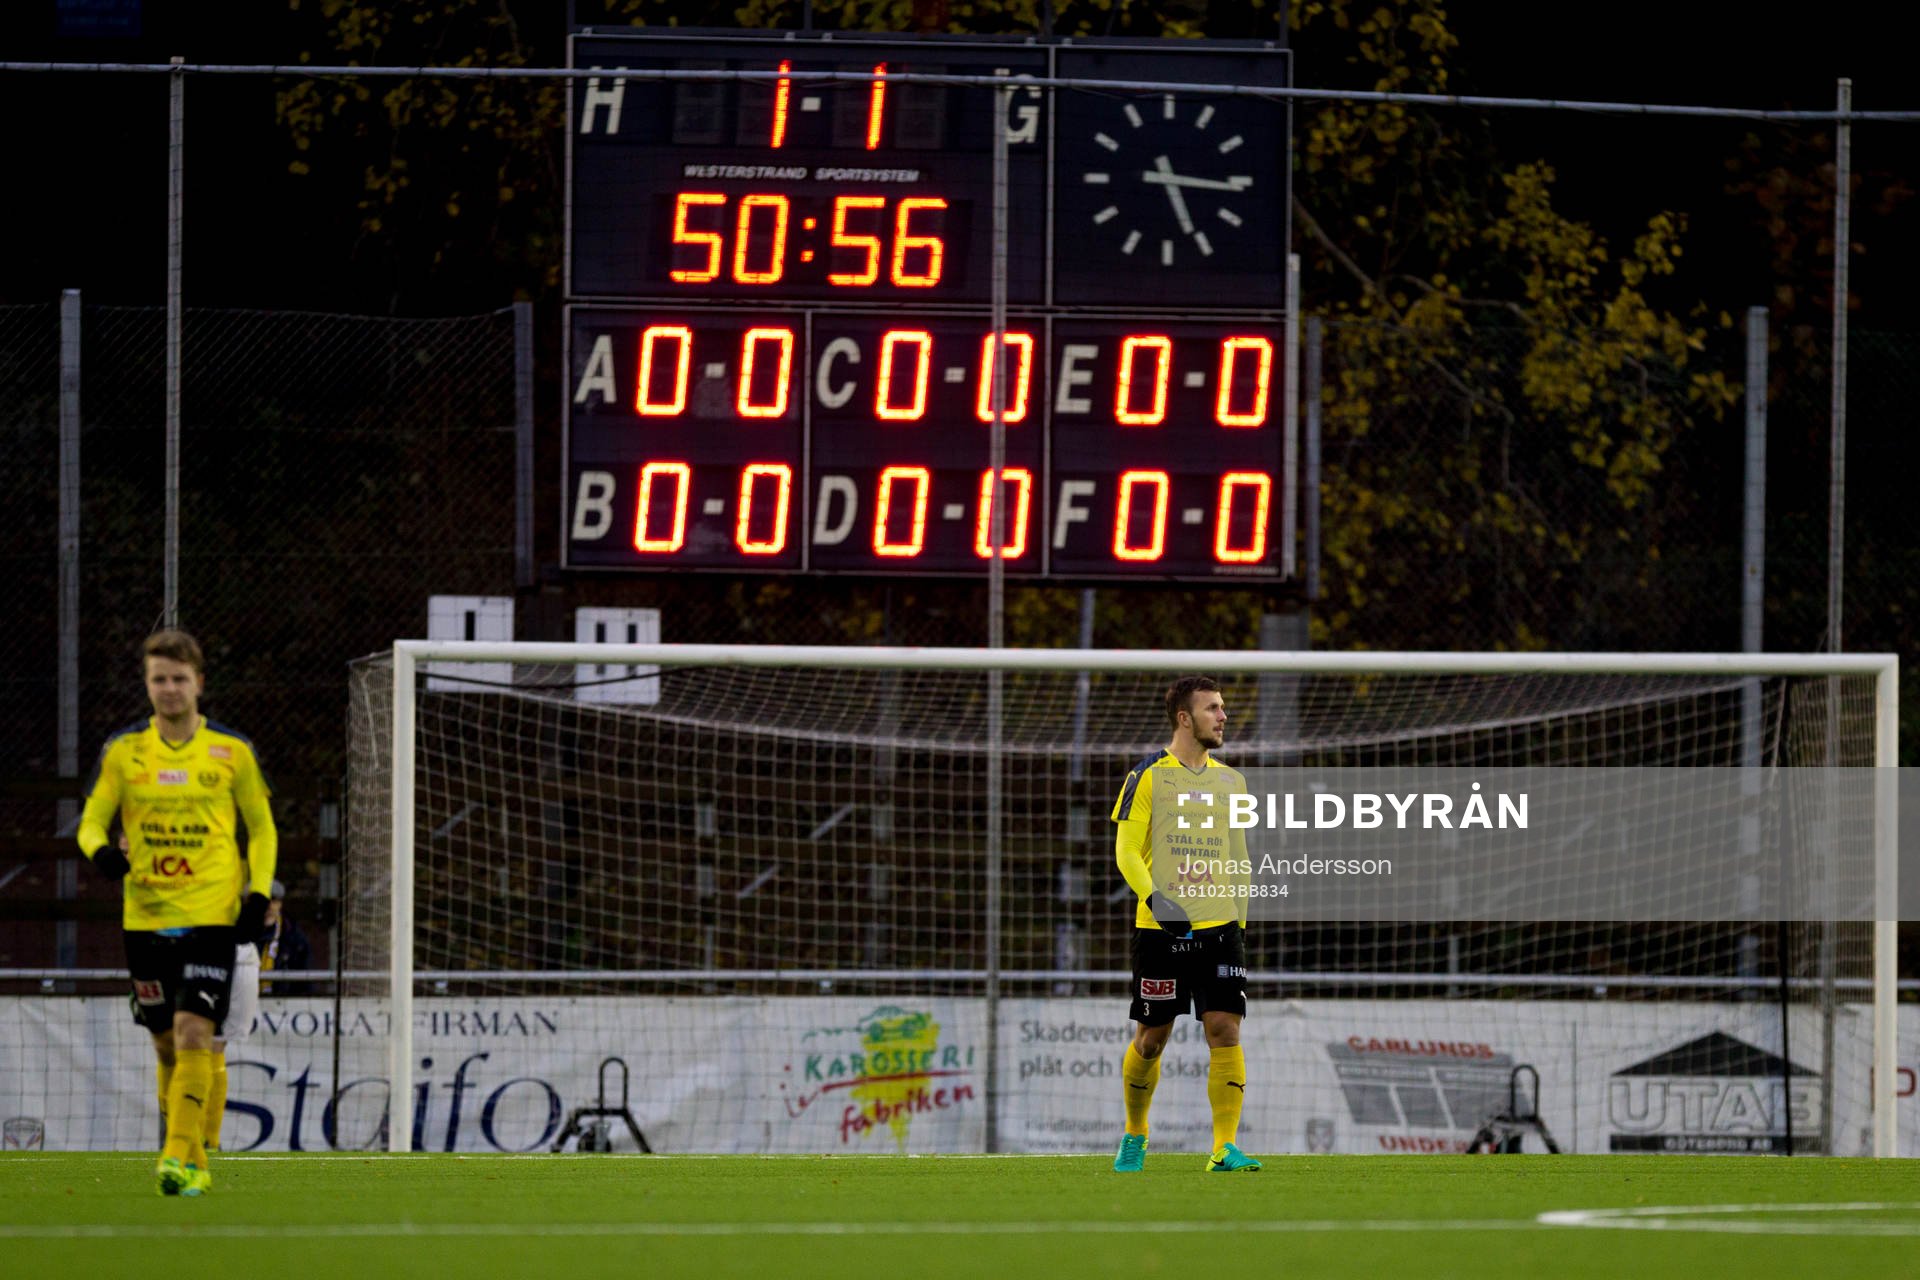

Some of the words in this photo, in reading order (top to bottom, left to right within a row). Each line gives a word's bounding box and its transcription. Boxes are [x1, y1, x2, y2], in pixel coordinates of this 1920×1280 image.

[581, 67, 628, 134] H
[685, 165, 807, 179] WESTERSTRAND
[816, 168, 920, 181] SPORTSYSTEM
[669, 192, 948, 287] 50:56
[575, 335, 617, 403] A
[816, 338, 861, 408] C
[1056, 345, 1098, 413] E
[572, 472, 616, 540] B
[813, 476, 858, 545] D
[1053, 481, 1096, 549] F
[152, 856, 193, 877] ICA
[1166, 834, 1193, 845] STÅL
[1142, 980, 1174, 996] SVB
[1143, 1002, 1150, 1016] 3
[805, 1045, 975, 1083] KAROSSERI
[1018, 1056, 1063, 1080] plåt
[1069, 1057, 1112, 1077] och
[1347, 1036, 1494, 1060] CARLUNDS
[839, 1084, 976, 1145] fabriken
[1609, 1080, 1824, 1132] UTAB
